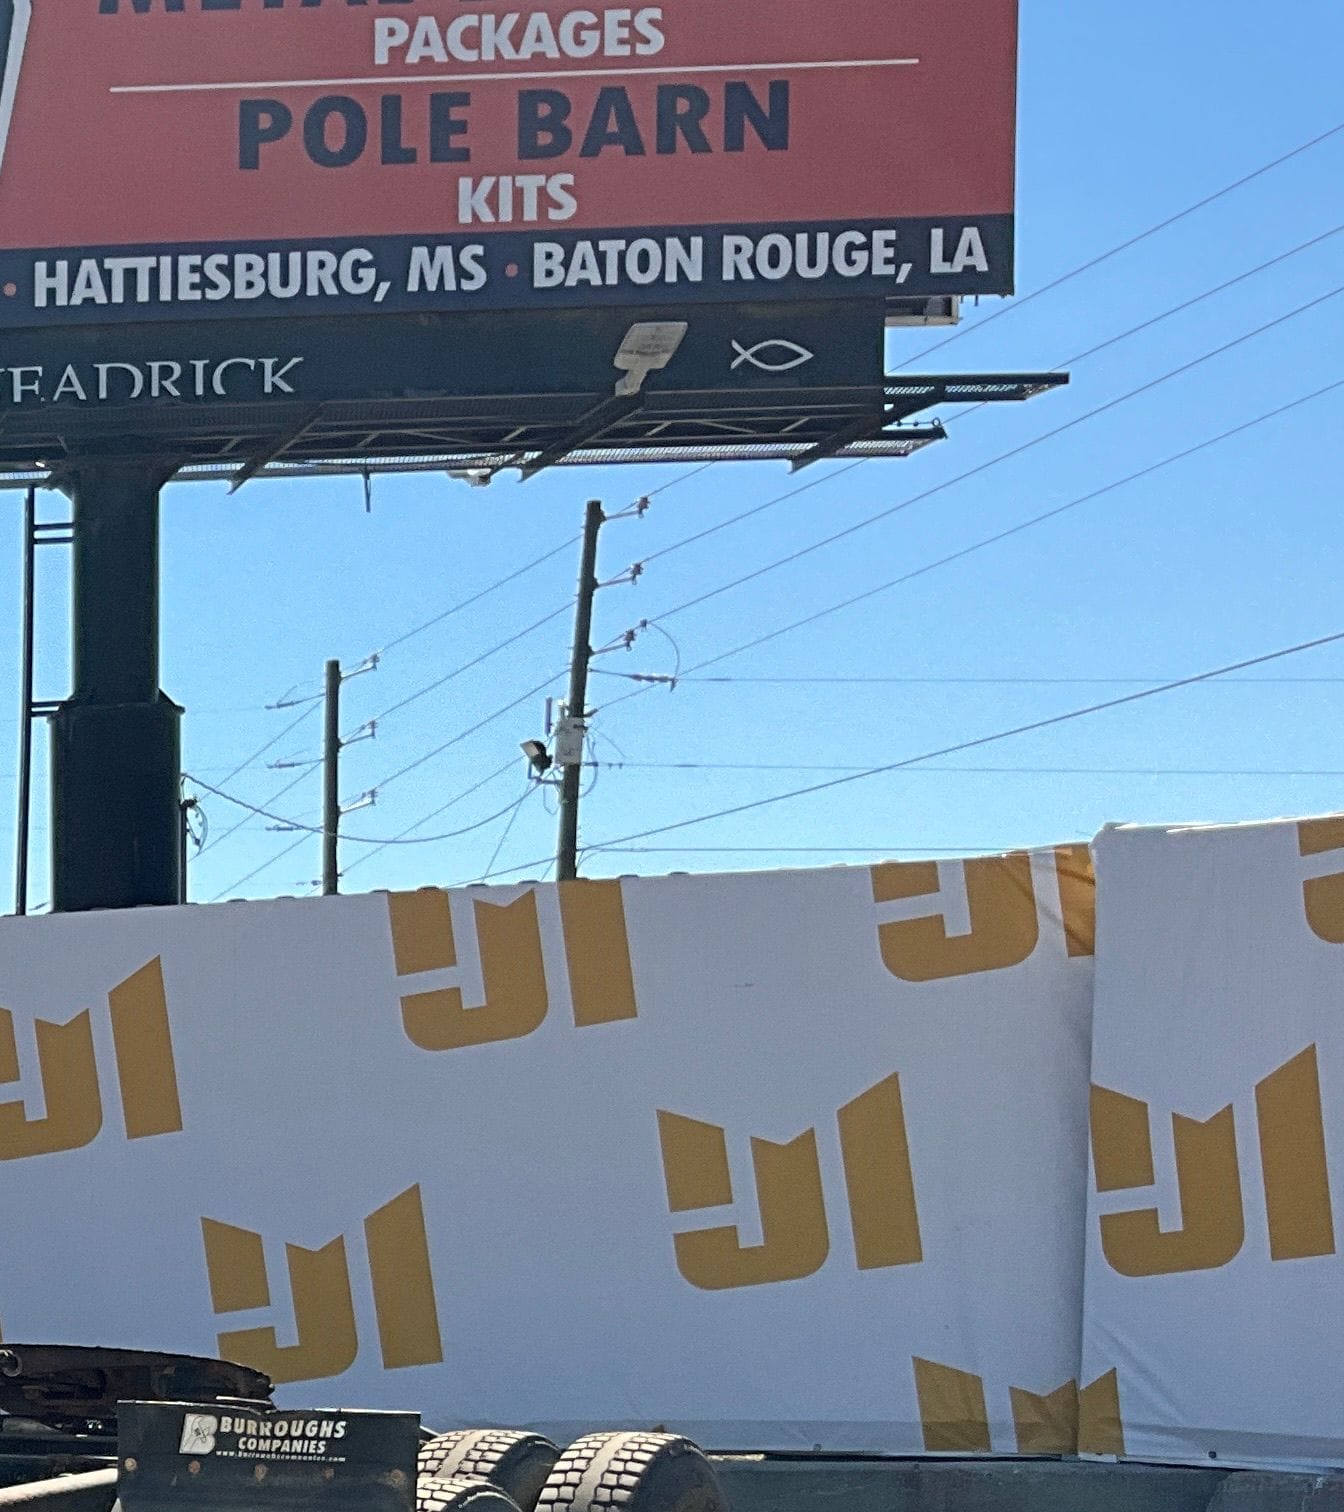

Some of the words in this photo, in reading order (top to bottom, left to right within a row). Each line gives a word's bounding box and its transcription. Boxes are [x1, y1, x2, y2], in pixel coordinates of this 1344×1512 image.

[374, 7, 665, 65] PACKAGES
[238, 92, 471, 170] POLE
[518, 80, 789, 160] BARN
[458, 172, 578, 224] KITS
[34, 247, 392, 308] HATTIESBURG,
[407, 244, 487, 293] MS
[533, 236, 703, 289] BATON
[721, 229, 913, 284] ROUGE,
[928, 226, 989, 276] LA
[220, 1416, 346, 1438] BURROUGHS
[238, 1437, 326, 1454] COMPANIES
